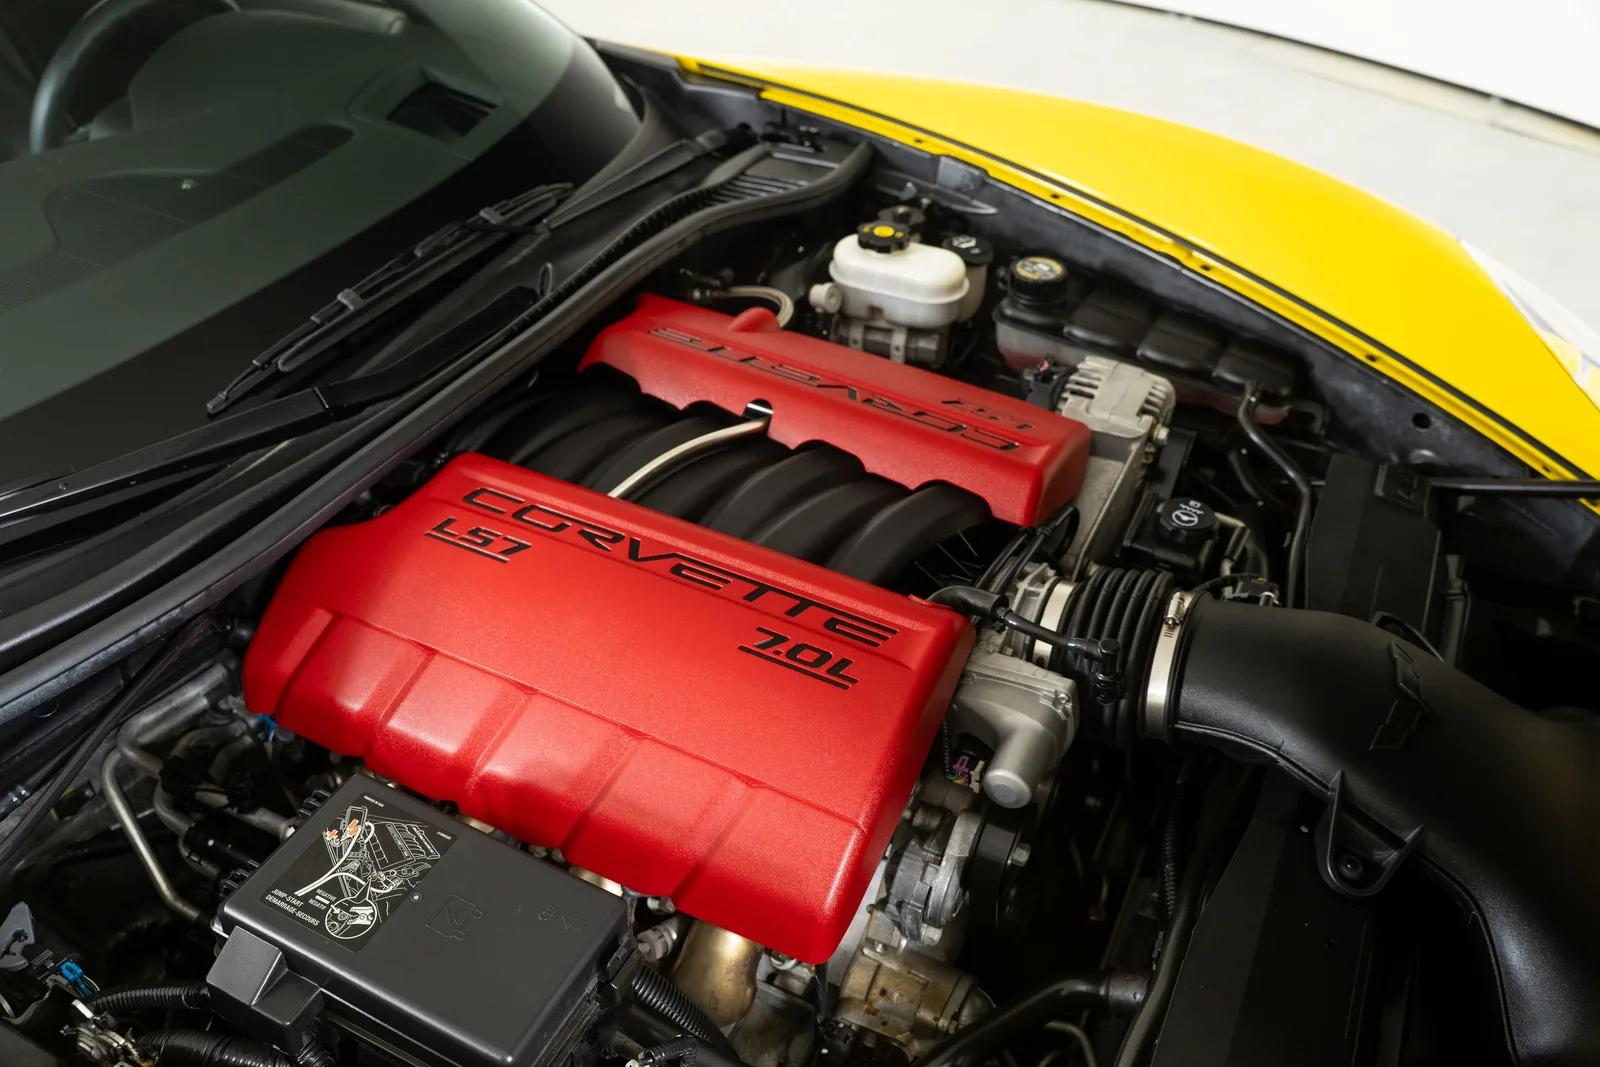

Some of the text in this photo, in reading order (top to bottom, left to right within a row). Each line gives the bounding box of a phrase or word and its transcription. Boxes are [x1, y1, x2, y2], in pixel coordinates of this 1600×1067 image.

[648, 328, 1020, 451] CORVETTE
[427, 517, 533, 560] LS7
[462, 487, 900, 648] CORVETTE
[745, 626, 860, 686] 7.0L
[271, 888, 304, 907] JUMP-START
